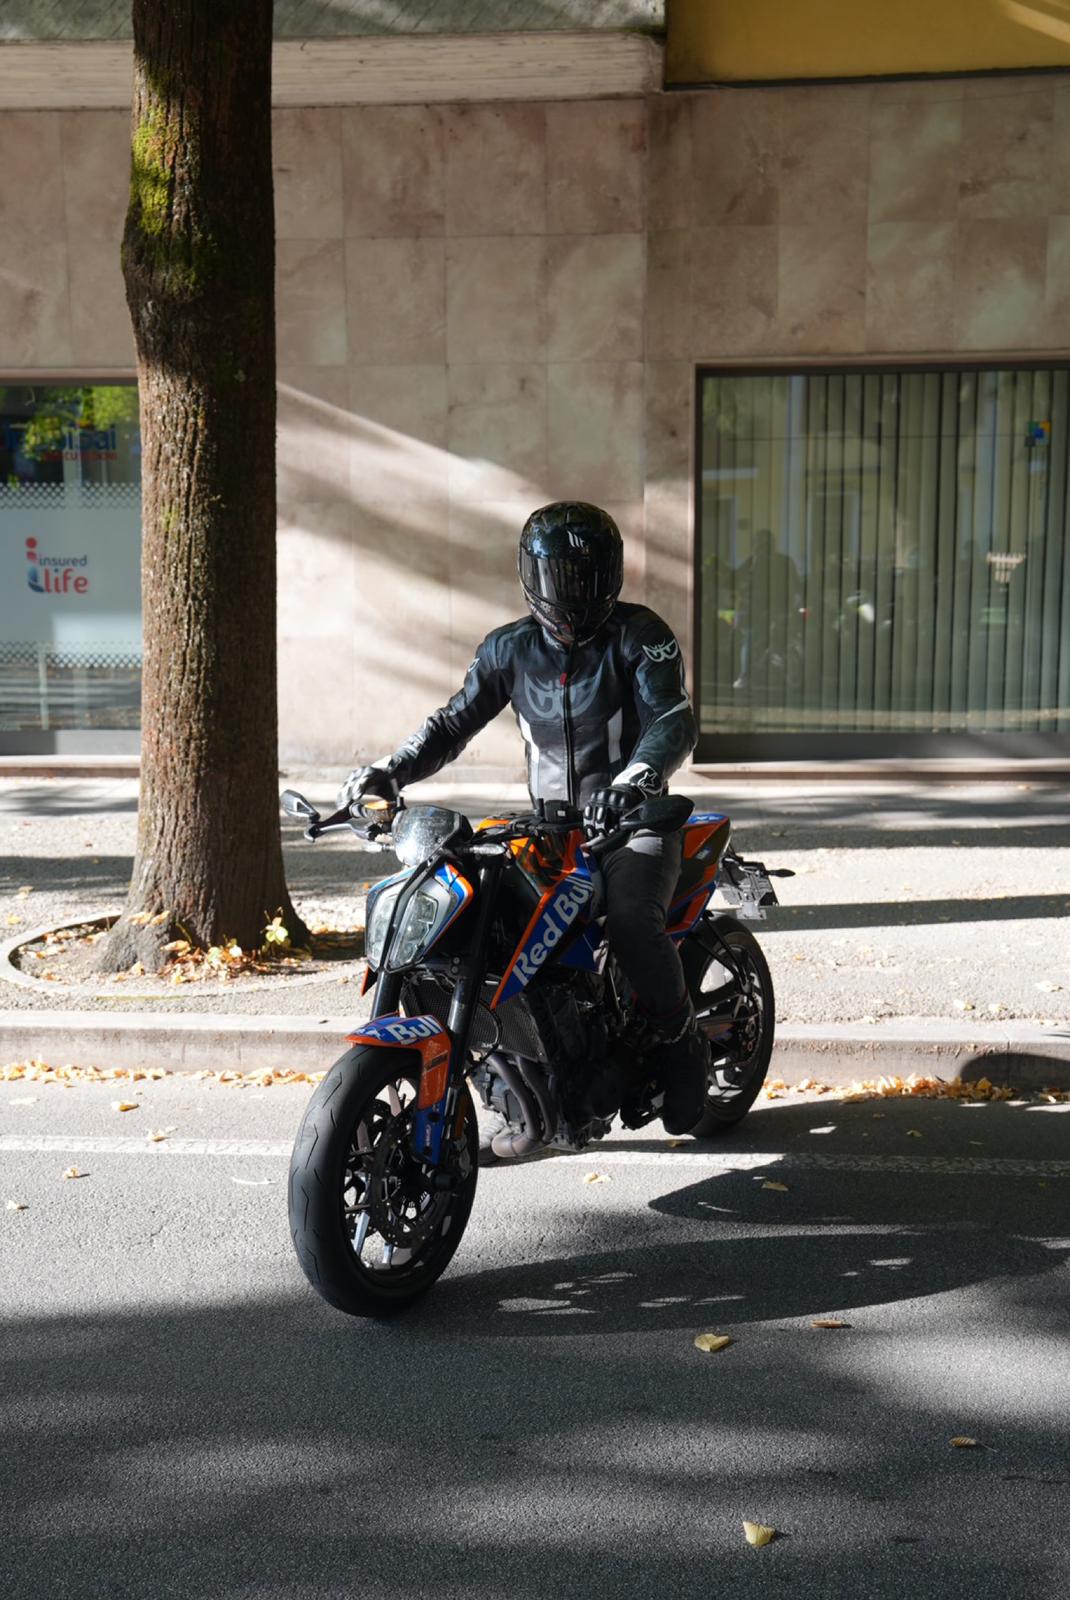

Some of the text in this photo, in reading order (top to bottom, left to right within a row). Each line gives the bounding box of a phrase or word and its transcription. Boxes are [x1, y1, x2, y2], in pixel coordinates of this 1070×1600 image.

[39, 554, 88, 567] insured
[44, 568, 89, 593] life
[512, 875, 594, 986] Red Bull
[385, 1015, 444, 1046] Bull
